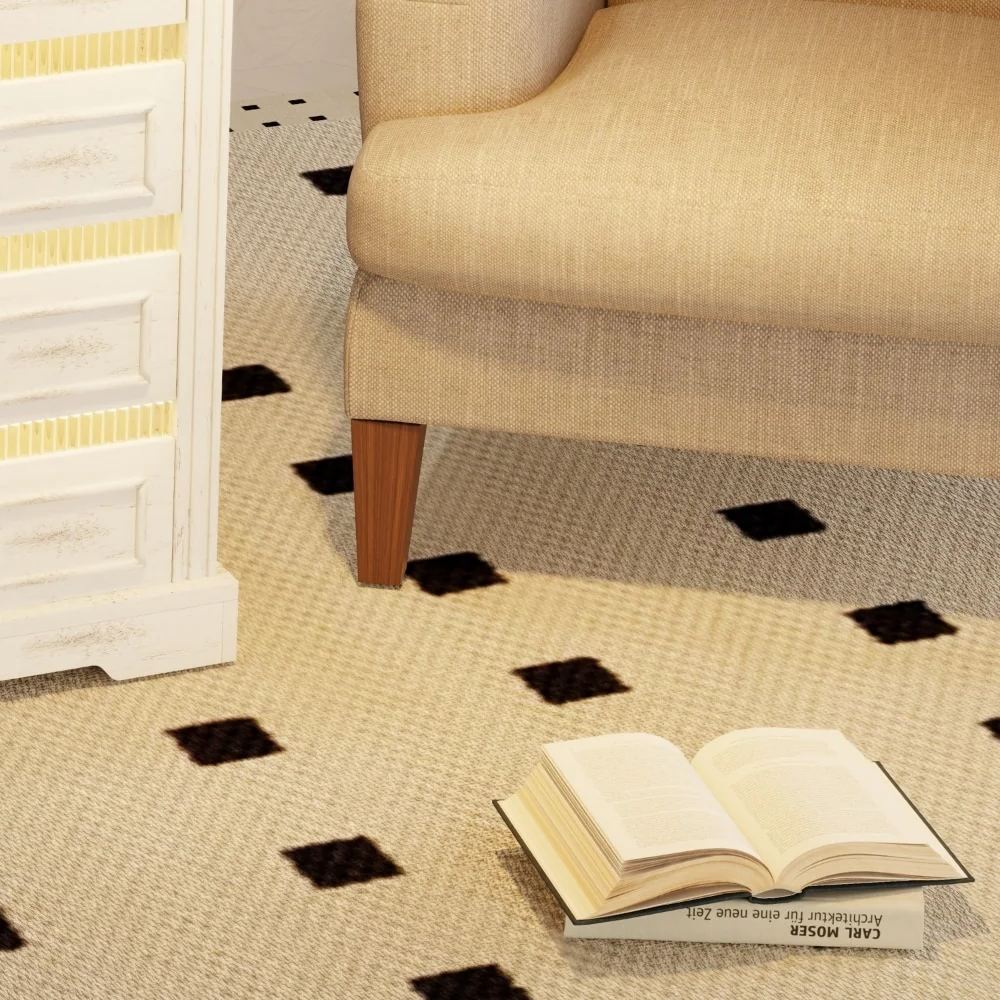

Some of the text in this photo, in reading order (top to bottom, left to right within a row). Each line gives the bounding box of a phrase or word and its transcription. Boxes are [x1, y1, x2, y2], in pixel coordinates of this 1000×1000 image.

[686, 906, 883, 926] Architektur für eine neue Zeit
[790, 924, 881, 939] CARL MOSER
